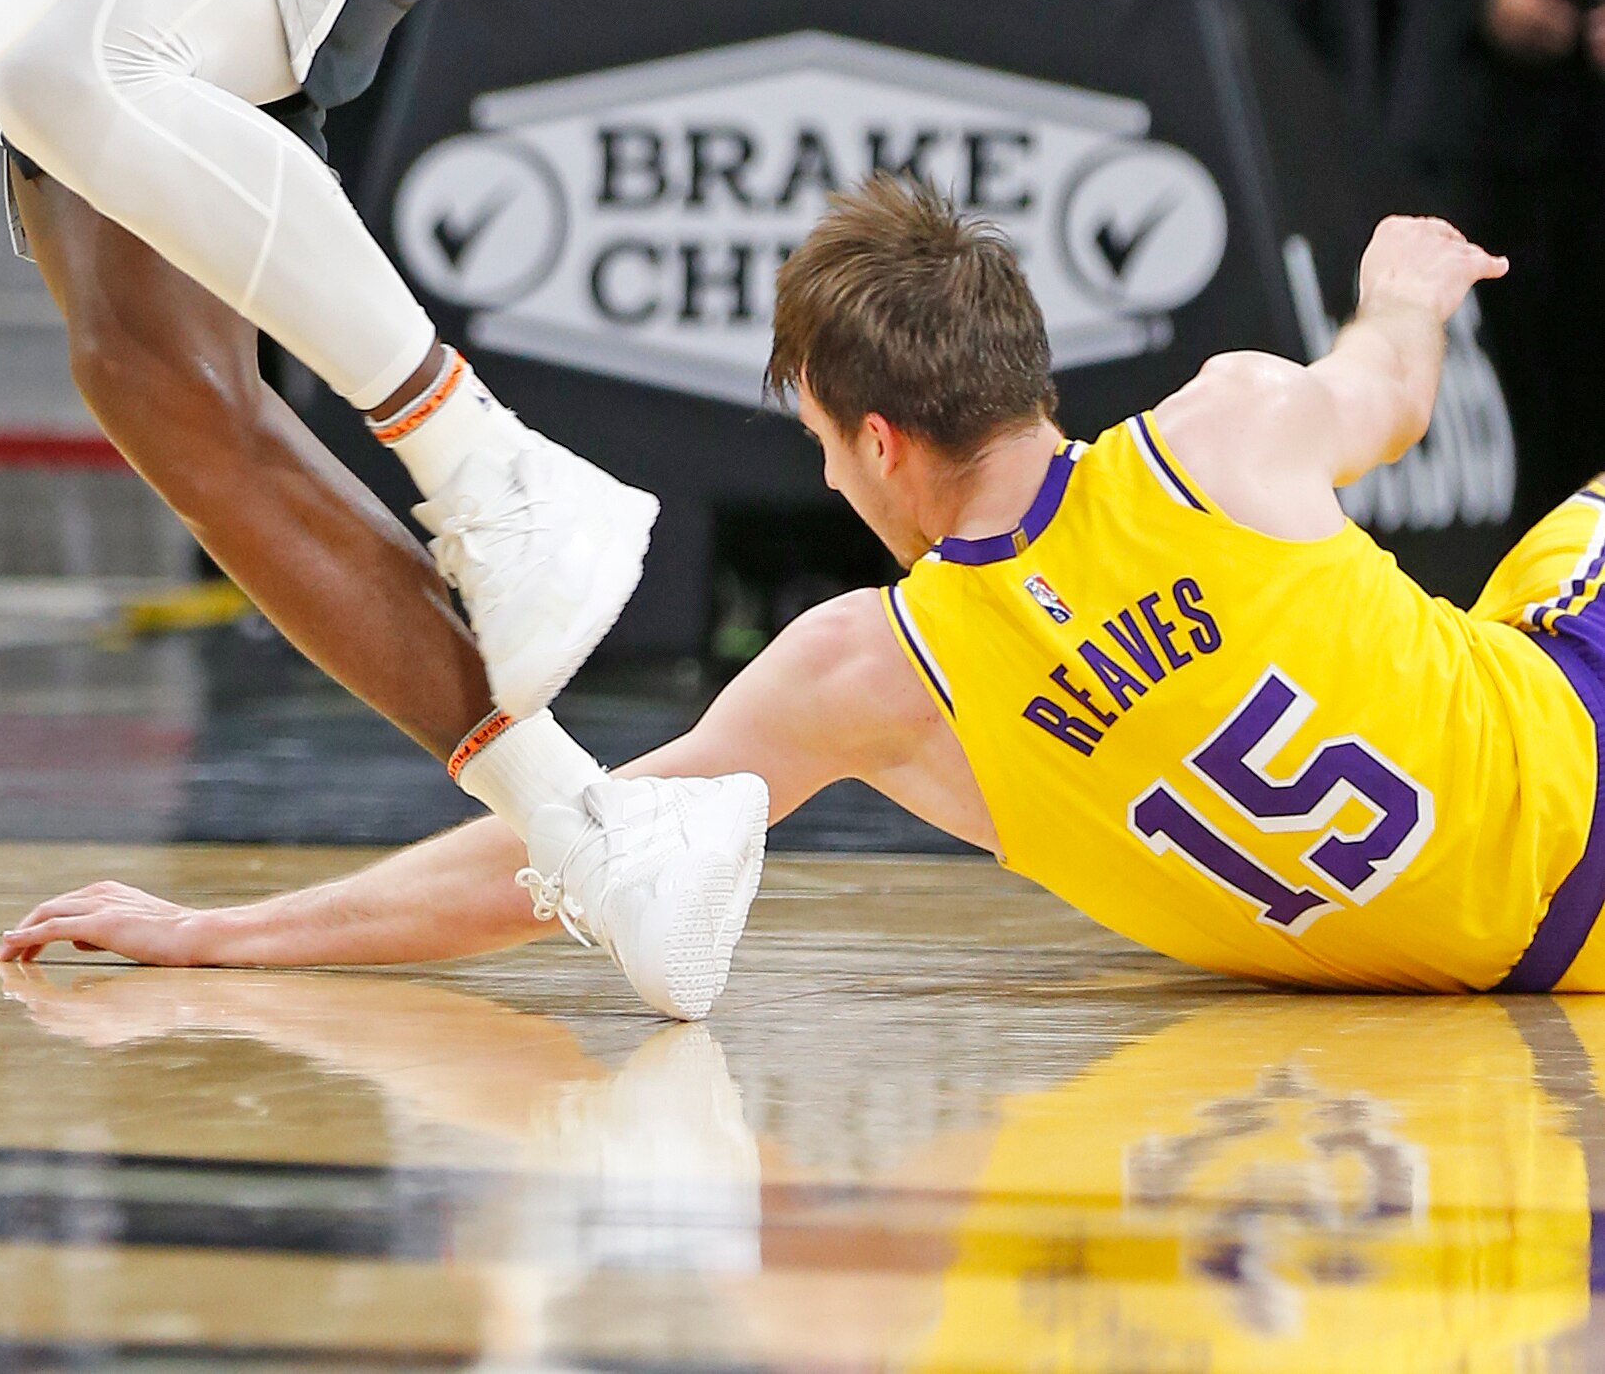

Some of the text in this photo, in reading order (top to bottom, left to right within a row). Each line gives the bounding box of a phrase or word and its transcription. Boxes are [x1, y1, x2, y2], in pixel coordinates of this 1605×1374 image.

[595, 128, 1033, 212] BRAKE
[1022, 577, 1223, 758] REAVES
[1127, 663, 1435, 937] 15
